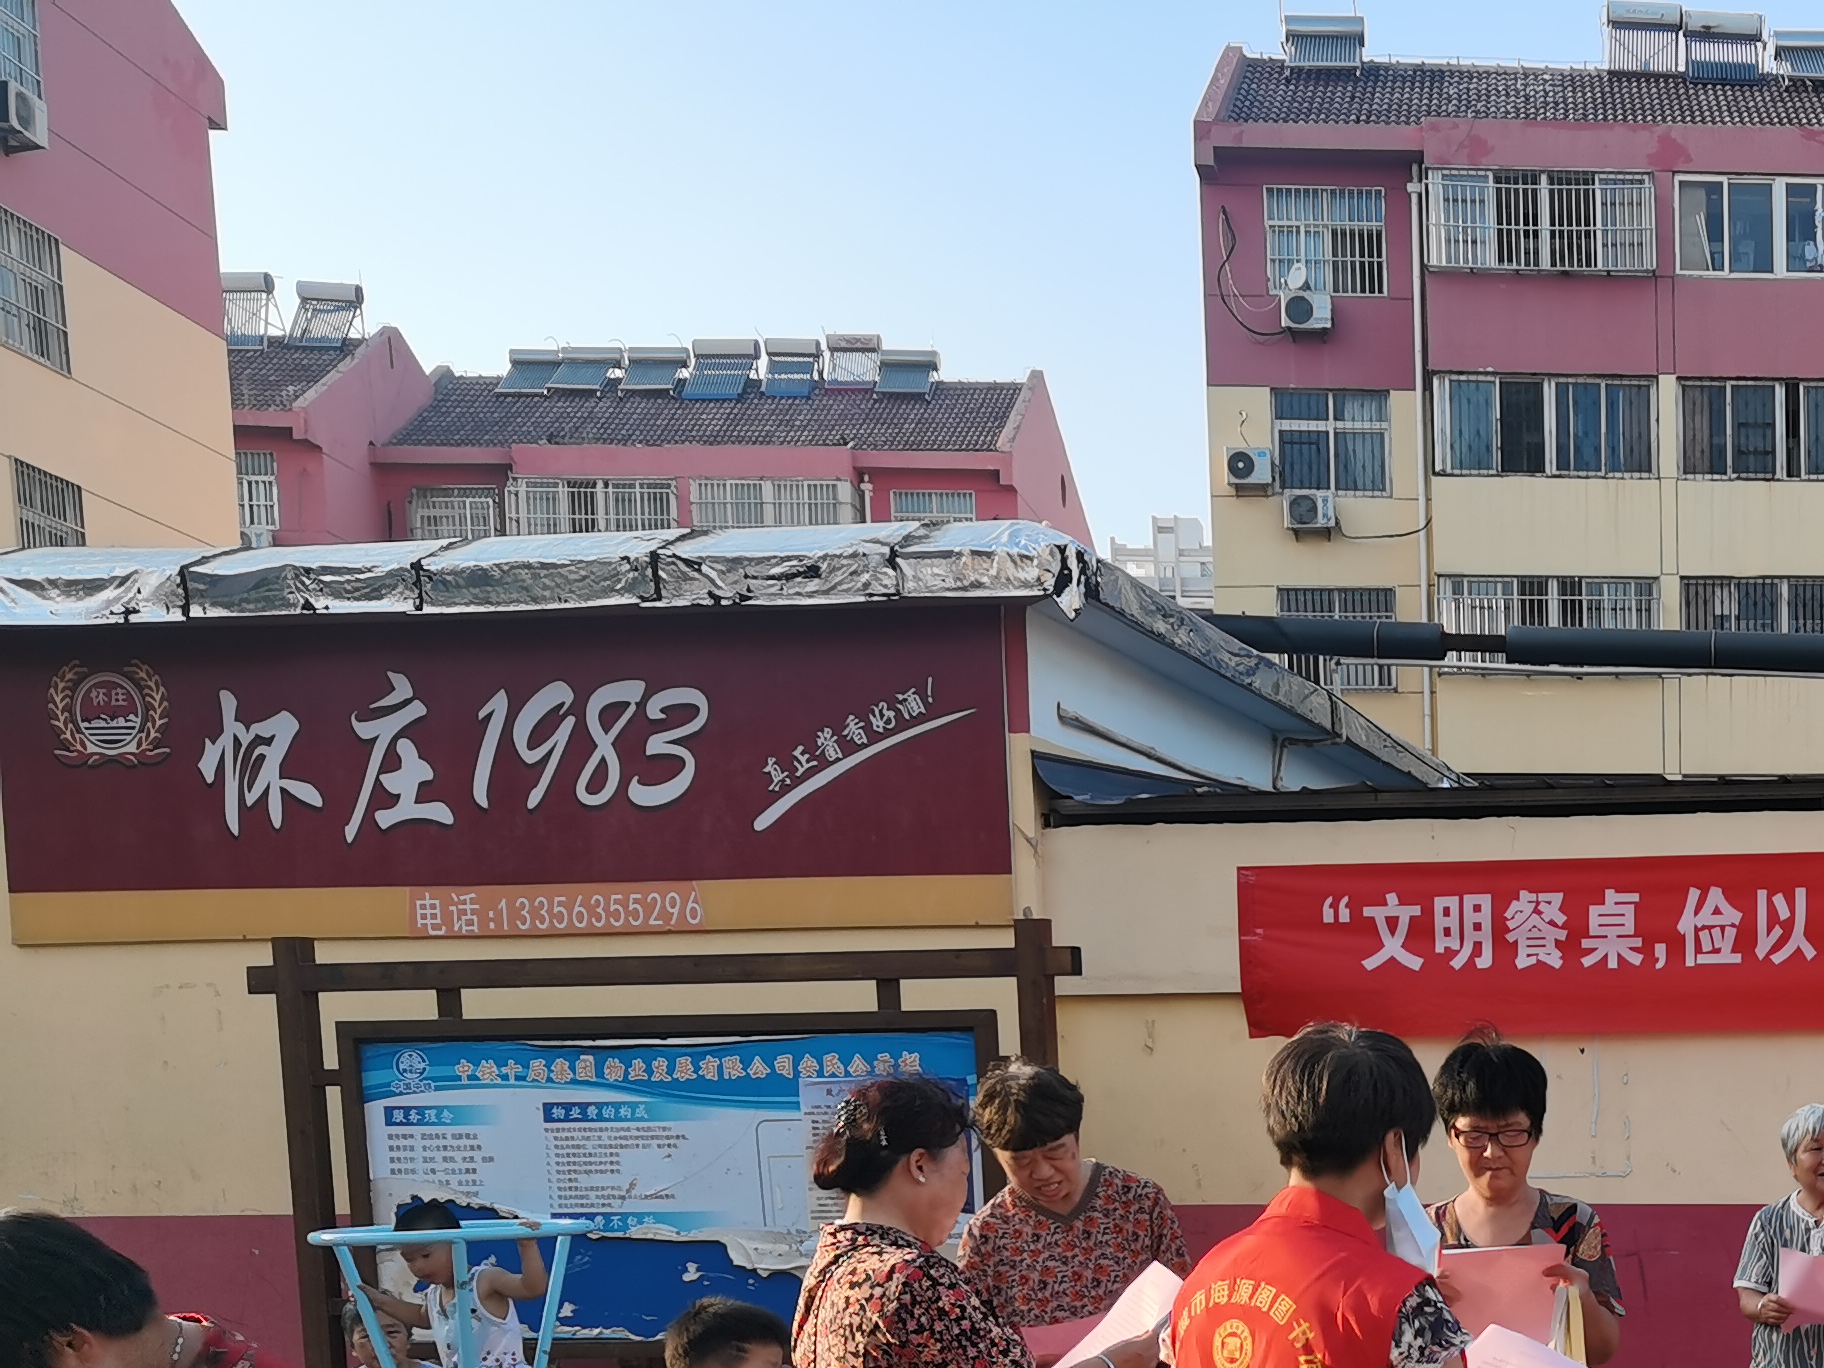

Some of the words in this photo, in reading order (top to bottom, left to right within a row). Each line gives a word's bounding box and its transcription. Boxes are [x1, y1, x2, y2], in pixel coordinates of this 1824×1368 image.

[90, 687, 128, 706] 怀庄
[414, 889, 704, 936] 电话:13356355296
[551, 1104, 648, 1120] 物业费的构成
